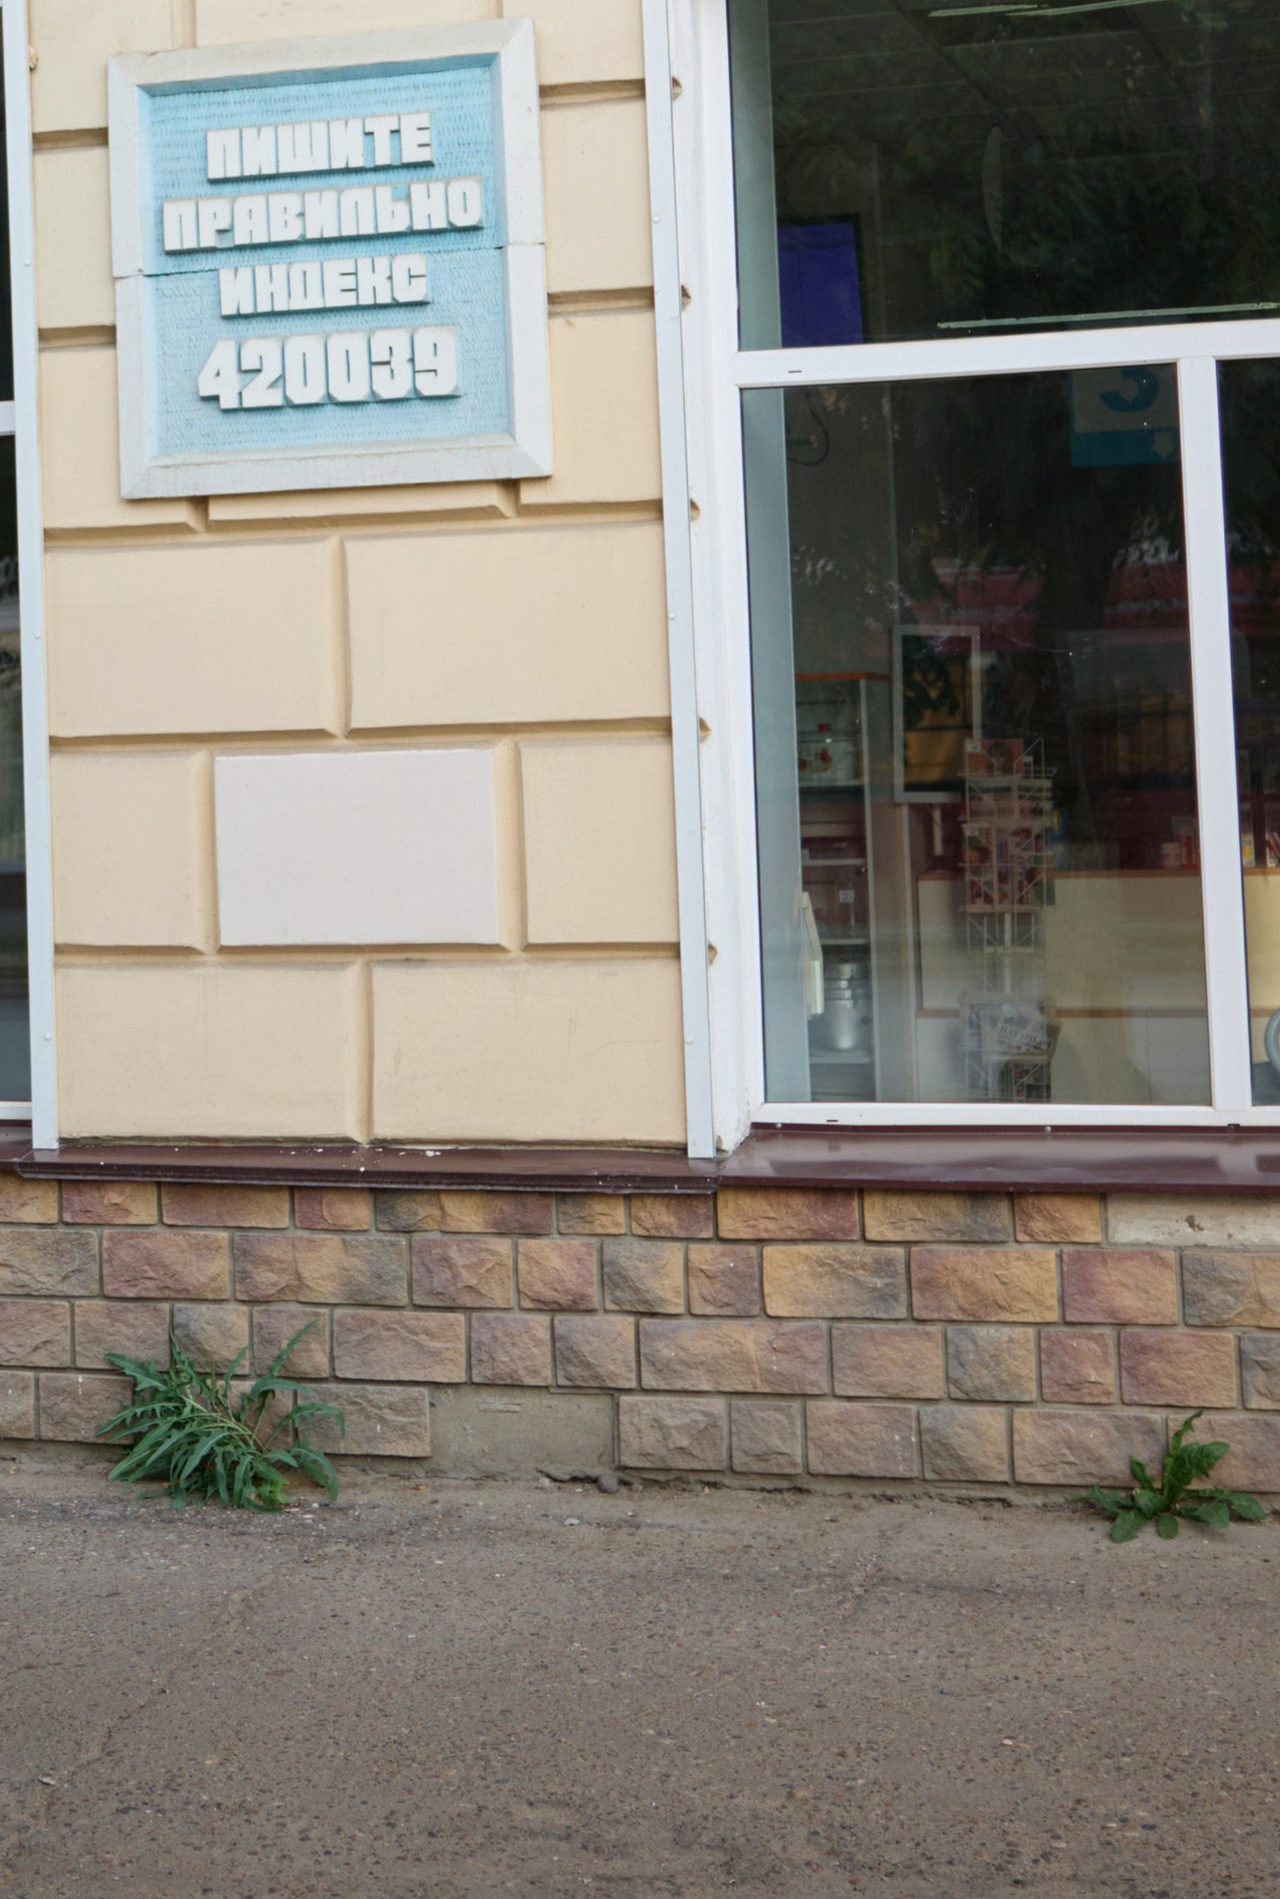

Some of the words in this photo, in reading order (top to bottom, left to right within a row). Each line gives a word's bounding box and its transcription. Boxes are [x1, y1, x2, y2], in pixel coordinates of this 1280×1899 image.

[206, 110, 435, 183] ПИШИТЕ
[163, 176, 485, 254] ПРАВИЛЬНО
[218, 253, 431, 319] ИНДЕКС
[197, 324, 462, 412] 420039
